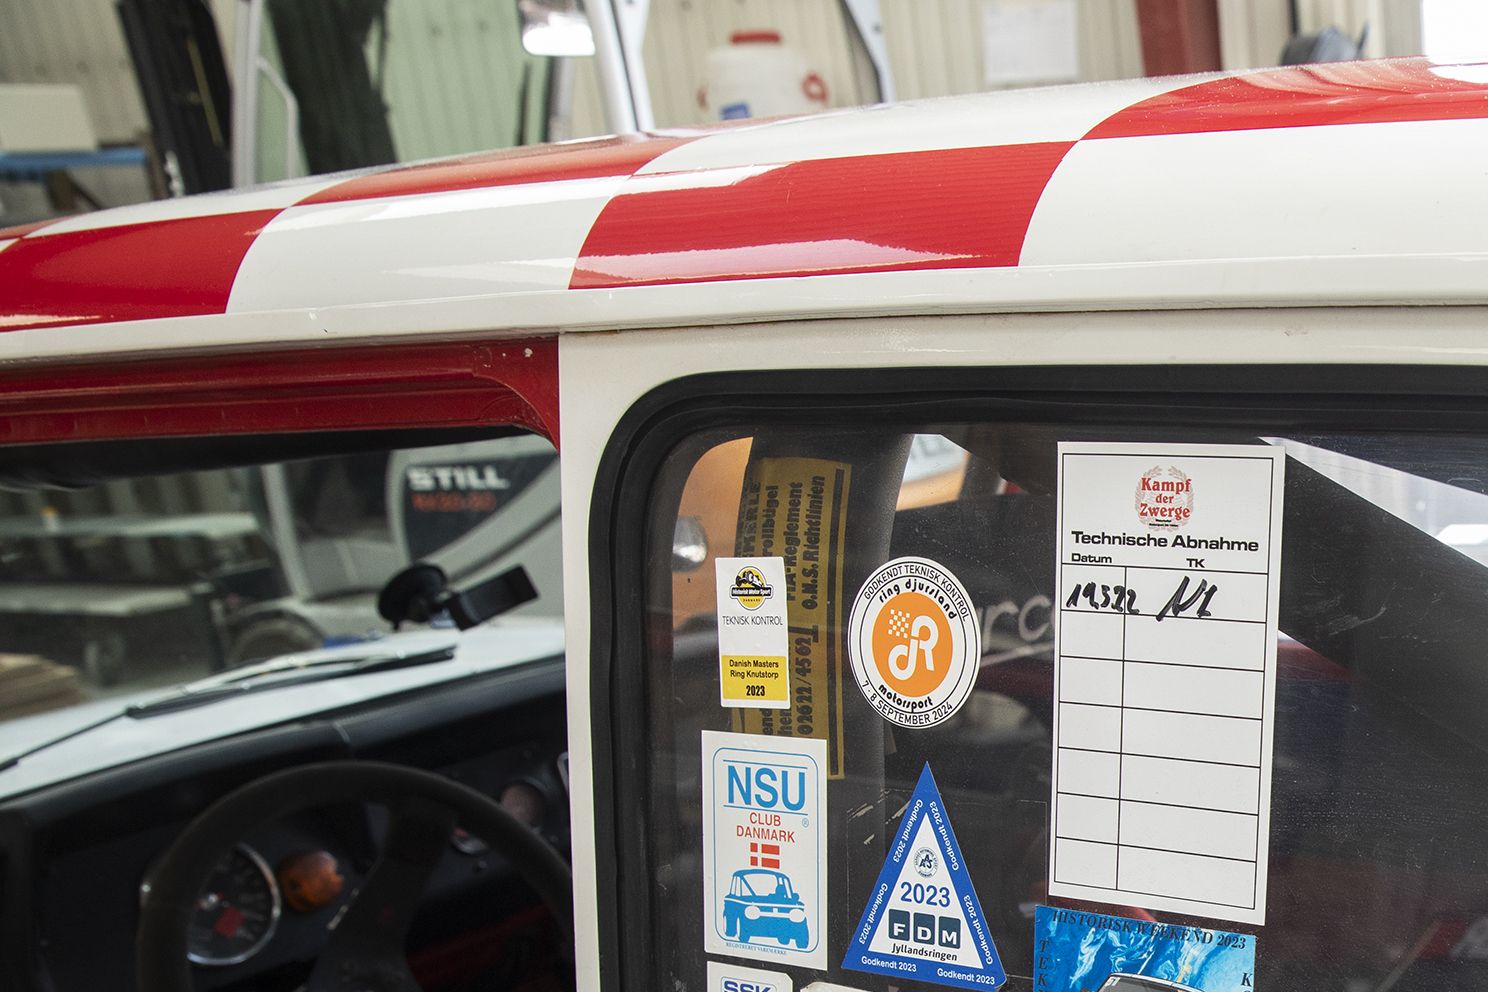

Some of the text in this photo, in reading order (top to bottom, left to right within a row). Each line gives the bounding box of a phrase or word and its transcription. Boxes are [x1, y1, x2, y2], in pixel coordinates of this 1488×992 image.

[407, 464, 511, 491] STILL
[1141, 477, 1192, 495] Kampf
[1155, 494, 1175, 504] der
[761, 485, 780, 558] rollbügel
[802, 475, 826, 562] Richtlinien
[1140, 502, 1191, 521] Zwerge
[1071, 530, 1259, 552] Technische Abnahme
[1071, 553, 1206, 569] Datum TK
[863, 564, 970, 622] GODKENDT TEKNISK KONTROL
[878, 578, 958, 620] ring djursland
[722, 615, 784, 626] TEKNISK KONTROL
[729, 659, 779, 668] Danish Masters
[730, 670, 779, 680] Ring Knutstorp
[746, 685, 766, 697] 2023
[878, 684, 934, 713] motorsport
[876, 699, 931, 725] SEPTEMBER
[932, 701, 953, 721] 2024
[727, 765, 806, 812] NSU
[749, 811, 782, 827] CLUB
[892, 799, 924, 863] Godkendt 2023
[736, 824, 796, 844] DANMARK
[929, 801, 960, 871] Godkendt 2023
[900, 881, 951, 908] 2023
[858, 882, 888, 945] Godkendt 2023
[963, 895, 994, 965] Godkendt 2023
[1052, 909, 1247, 950] HISTORISK WEEKEND 2023
[861, 955, 917, 973] Godkendt 2023
[891, 943, 958, 962] Jyllandsringen
[936, 967, 996, 986] Godkendt 2023
